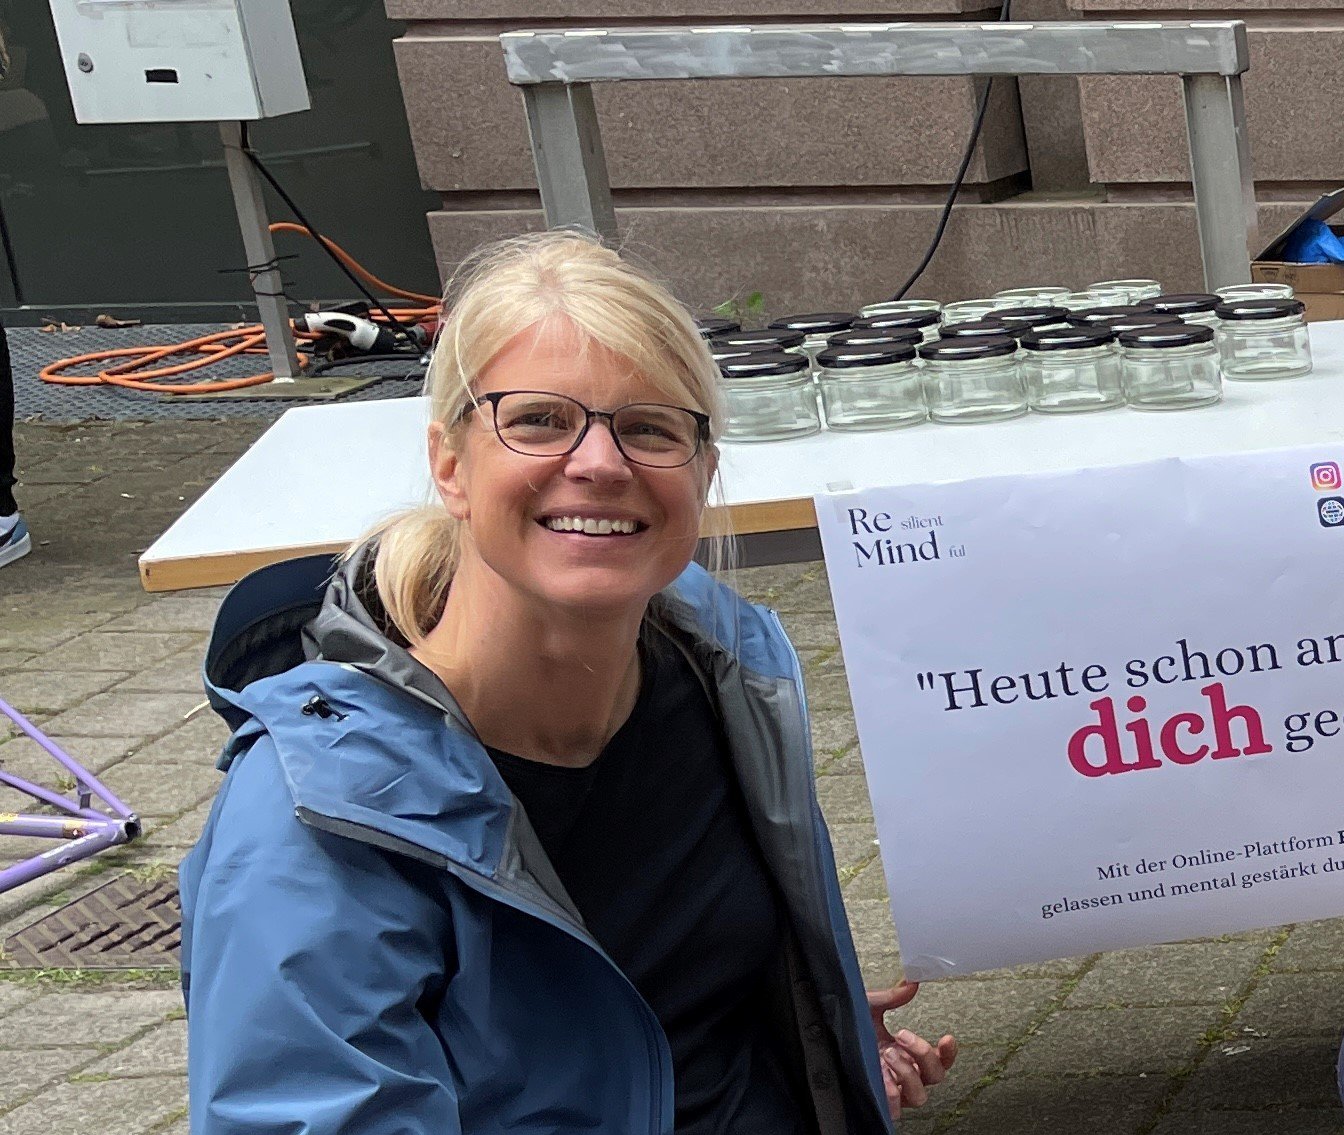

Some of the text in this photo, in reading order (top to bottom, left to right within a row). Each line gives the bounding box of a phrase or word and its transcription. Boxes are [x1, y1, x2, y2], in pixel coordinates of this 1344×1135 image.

[847, 507, 945, 536] Re silient
[852, 529, 967, 568] Mind ful
[916, 661, 1111, 712] "Heute
[1125, 638, 1283, 689] schon
[1066, 682, 1273, 778] dich
[1096, 862, 1131, 881] Mit
[1135, 858, 1168, 875] der
[1172, 836, 1335, 869] Online-Plattform
[1041, 893, 1124, 920] gelassen
[1127, 882, 1166, 901] und
[1170, 871, 1237, 897] mental
[1241, 861, 1319, 889] gestärkt
